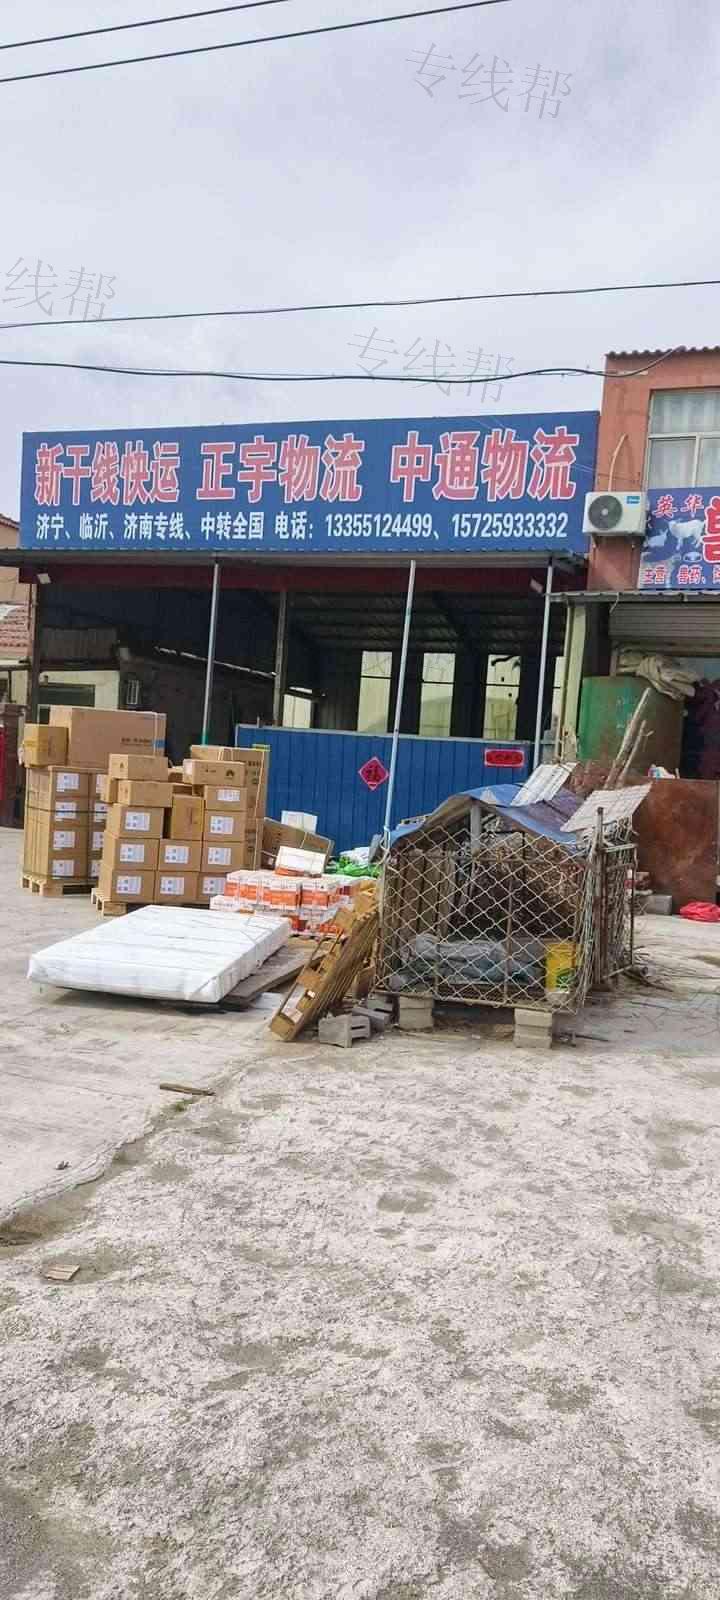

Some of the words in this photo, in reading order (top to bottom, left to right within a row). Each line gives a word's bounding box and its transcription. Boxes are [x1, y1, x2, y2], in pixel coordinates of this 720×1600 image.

[34, 440, 181, 507] 新干线快运
[196, 432, 365, 503] 正宇物流
[391, 427, 579, 502] 中通物流
[36, 511, 265, 541] 济宁、临沂、济南专线、中转全国
